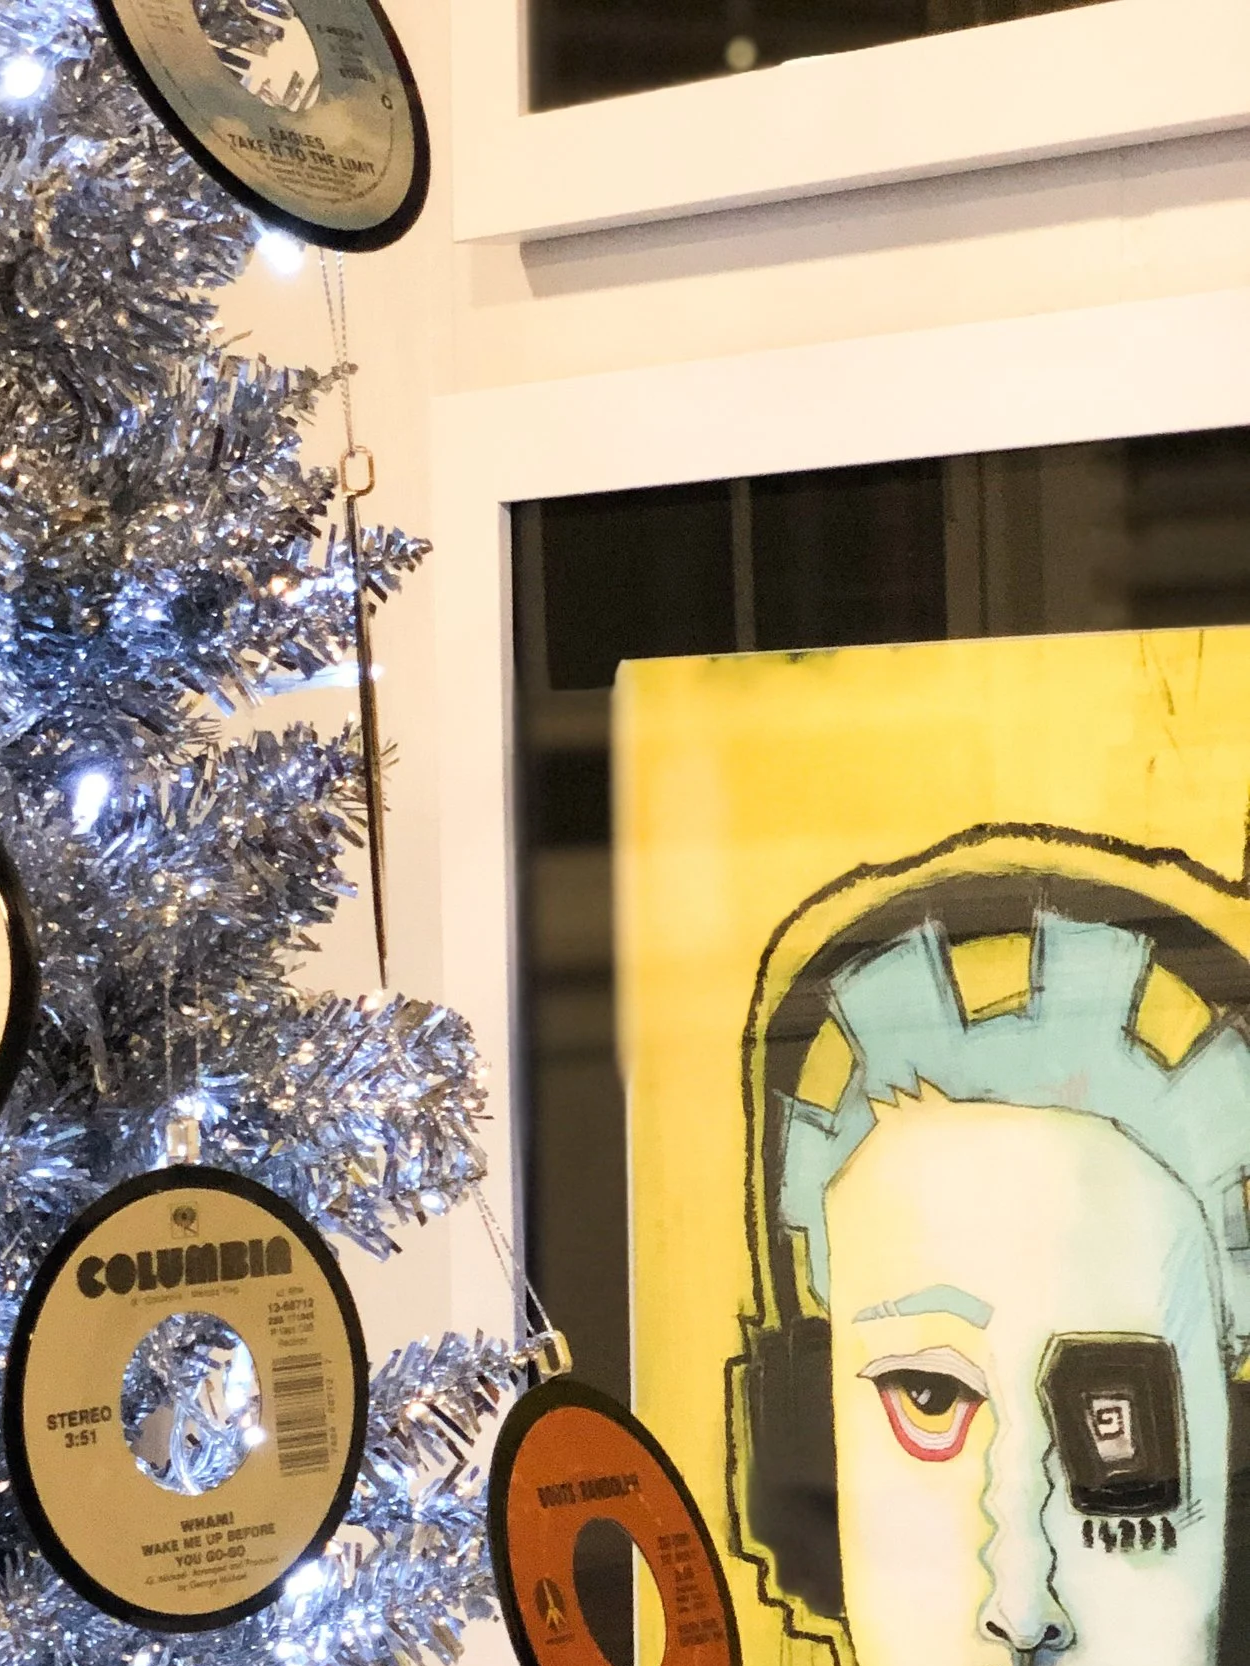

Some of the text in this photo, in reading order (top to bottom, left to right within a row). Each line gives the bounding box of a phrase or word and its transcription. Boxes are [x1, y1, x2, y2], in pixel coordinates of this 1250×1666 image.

[268, 126, 325, 150] EAGLES
[228, 133, 376, 177] TAKE IT TO THE LIMIT
[76, 1235, 293, 1299] COLUMBIA
[47, 1405, 112, 1431] STEREO
[64, 1429, 97, 1448] 3:51
[180, 1511, 234, 1532] WHAM!
[141, 1522, 276, 1556] WAKE ME UP BEFORE
[174, 1544, 246, 1567] YOU GO-GO
